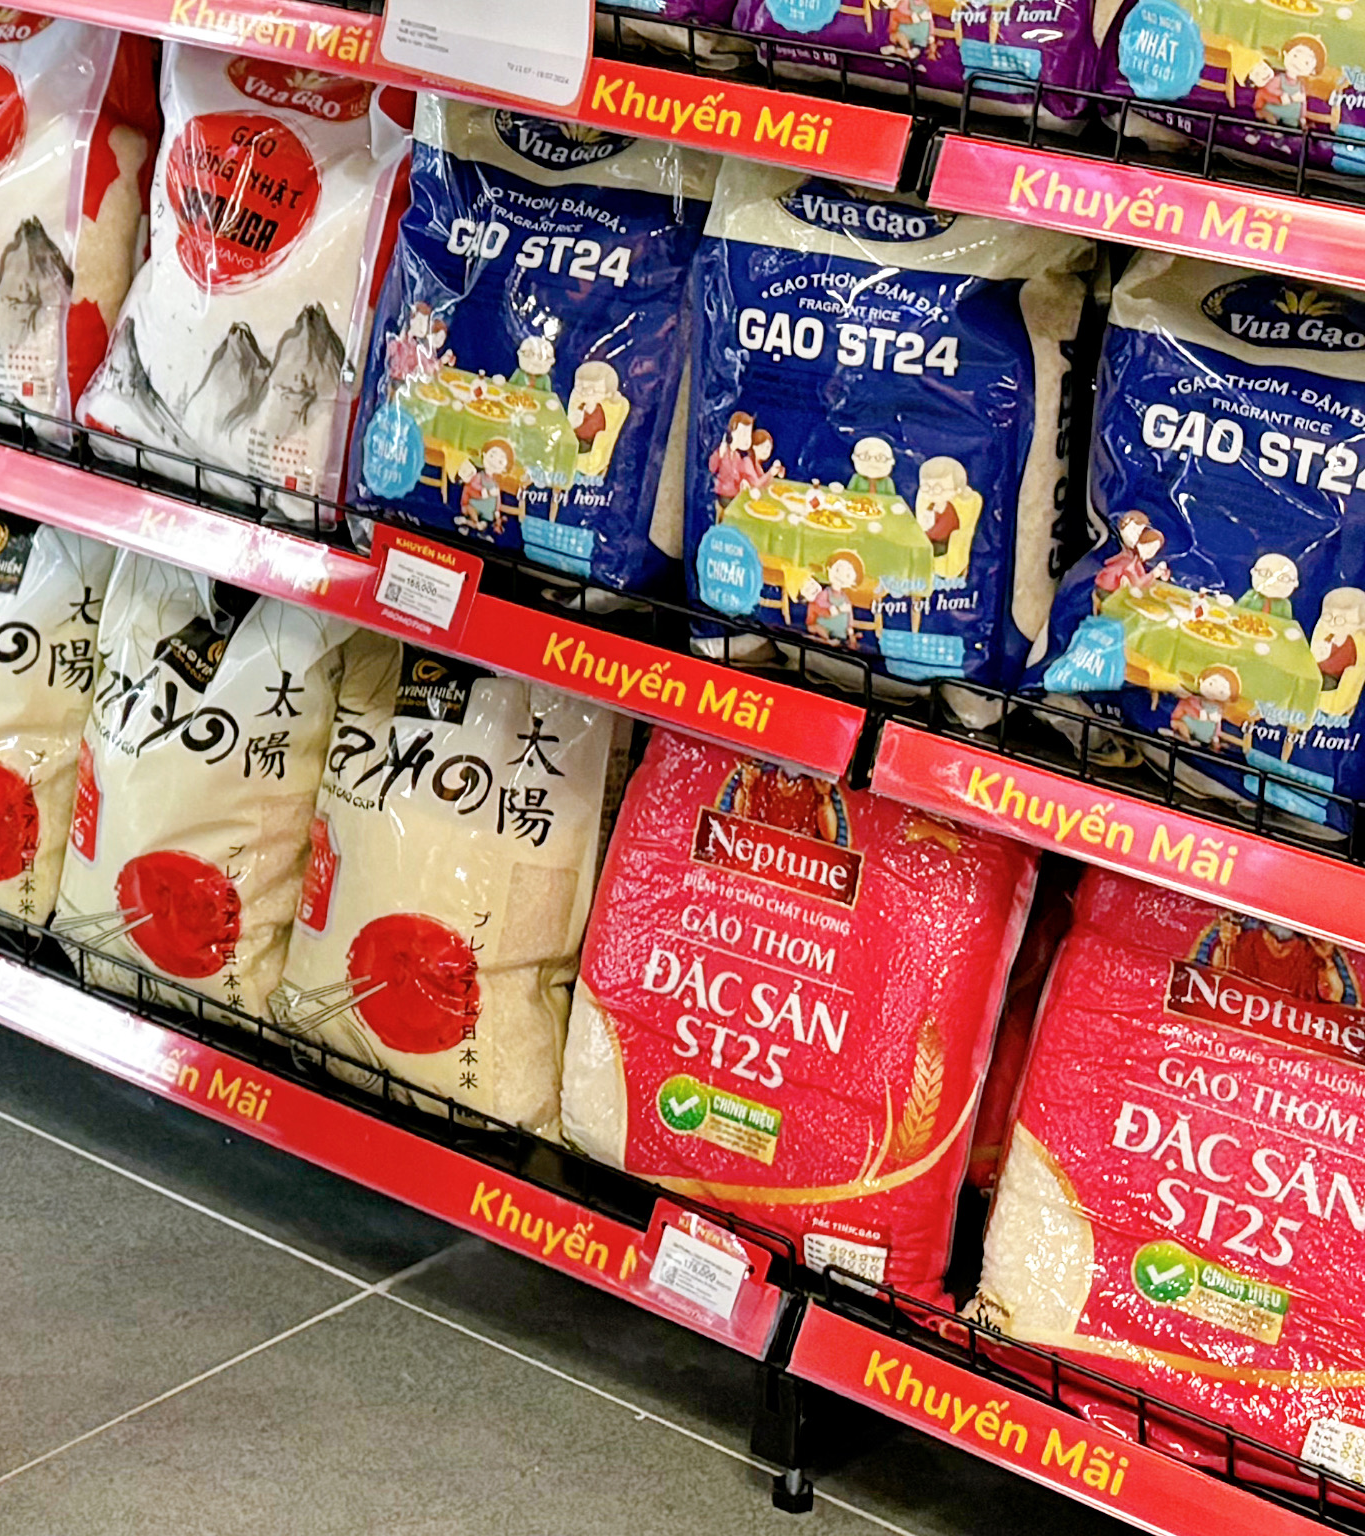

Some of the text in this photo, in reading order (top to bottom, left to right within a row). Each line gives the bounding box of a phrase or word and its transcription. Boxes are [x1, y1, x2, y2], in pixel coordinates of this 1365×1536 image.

[304, 17, 372, 64] Mãi
[950, 4, 1061, 26] trọn vị hơn!
[1136, 26, 1178, 65] NHẤT
[592, 72, 834, 157] Khuyến Mãi
[1165, 112, 1191, 134] 5 kg
[802, 193, 927, 239] Vua Gạo
[1009, 163, 1291, 253] Khuyến Mãi
[515, 235, 632, 289] ST24
[798, 297, 902, 323] FRAGRANT RICE
[1230, 313, 1365, 348] Vua Gạo
[738, 308, 959, 377] GẠO ST24
[1178, 373, 1351, 420] GẠO THƠM ĐẬM
[1212, 397, 1333, 436] FRAGRANT RICE
[396, 536, 457, 567] KHUYẾN MÃI
[870, 591, 979, 617] trọn vị hơn!
[542, 634, 774, 734] Khuyến Mãi
[1240, 721, 1281, 742] trọn
[1312, 729, 1362, 752] hơn!
[707, 815, 848, 891] Neptune
[965, 766, 1239, 886] Khuyến Mãi
[680, 904, 836, 975] GẠO THƠM
[735, 888, 852, 936] CHO CHẤT LƯỢNG
[641, 947, 850, 1055] ĐẶC SẢN
[1182, 965, 1365, 1055] Neptune
[672, 1013, 792, 1089] ST25
[209, 1067, 270, 1121] Mãi
[1157, 1056, 1360, 1146] GẠO THƠM
[1111, 1100, 1365, 1234] ĐẶC SẢN
[470, 1180, 609, 1270] Khuyến
[1149, 1177, 1304, 1268] ST25
[864, 1349, 1130, 1498] Khuyến Mãi
